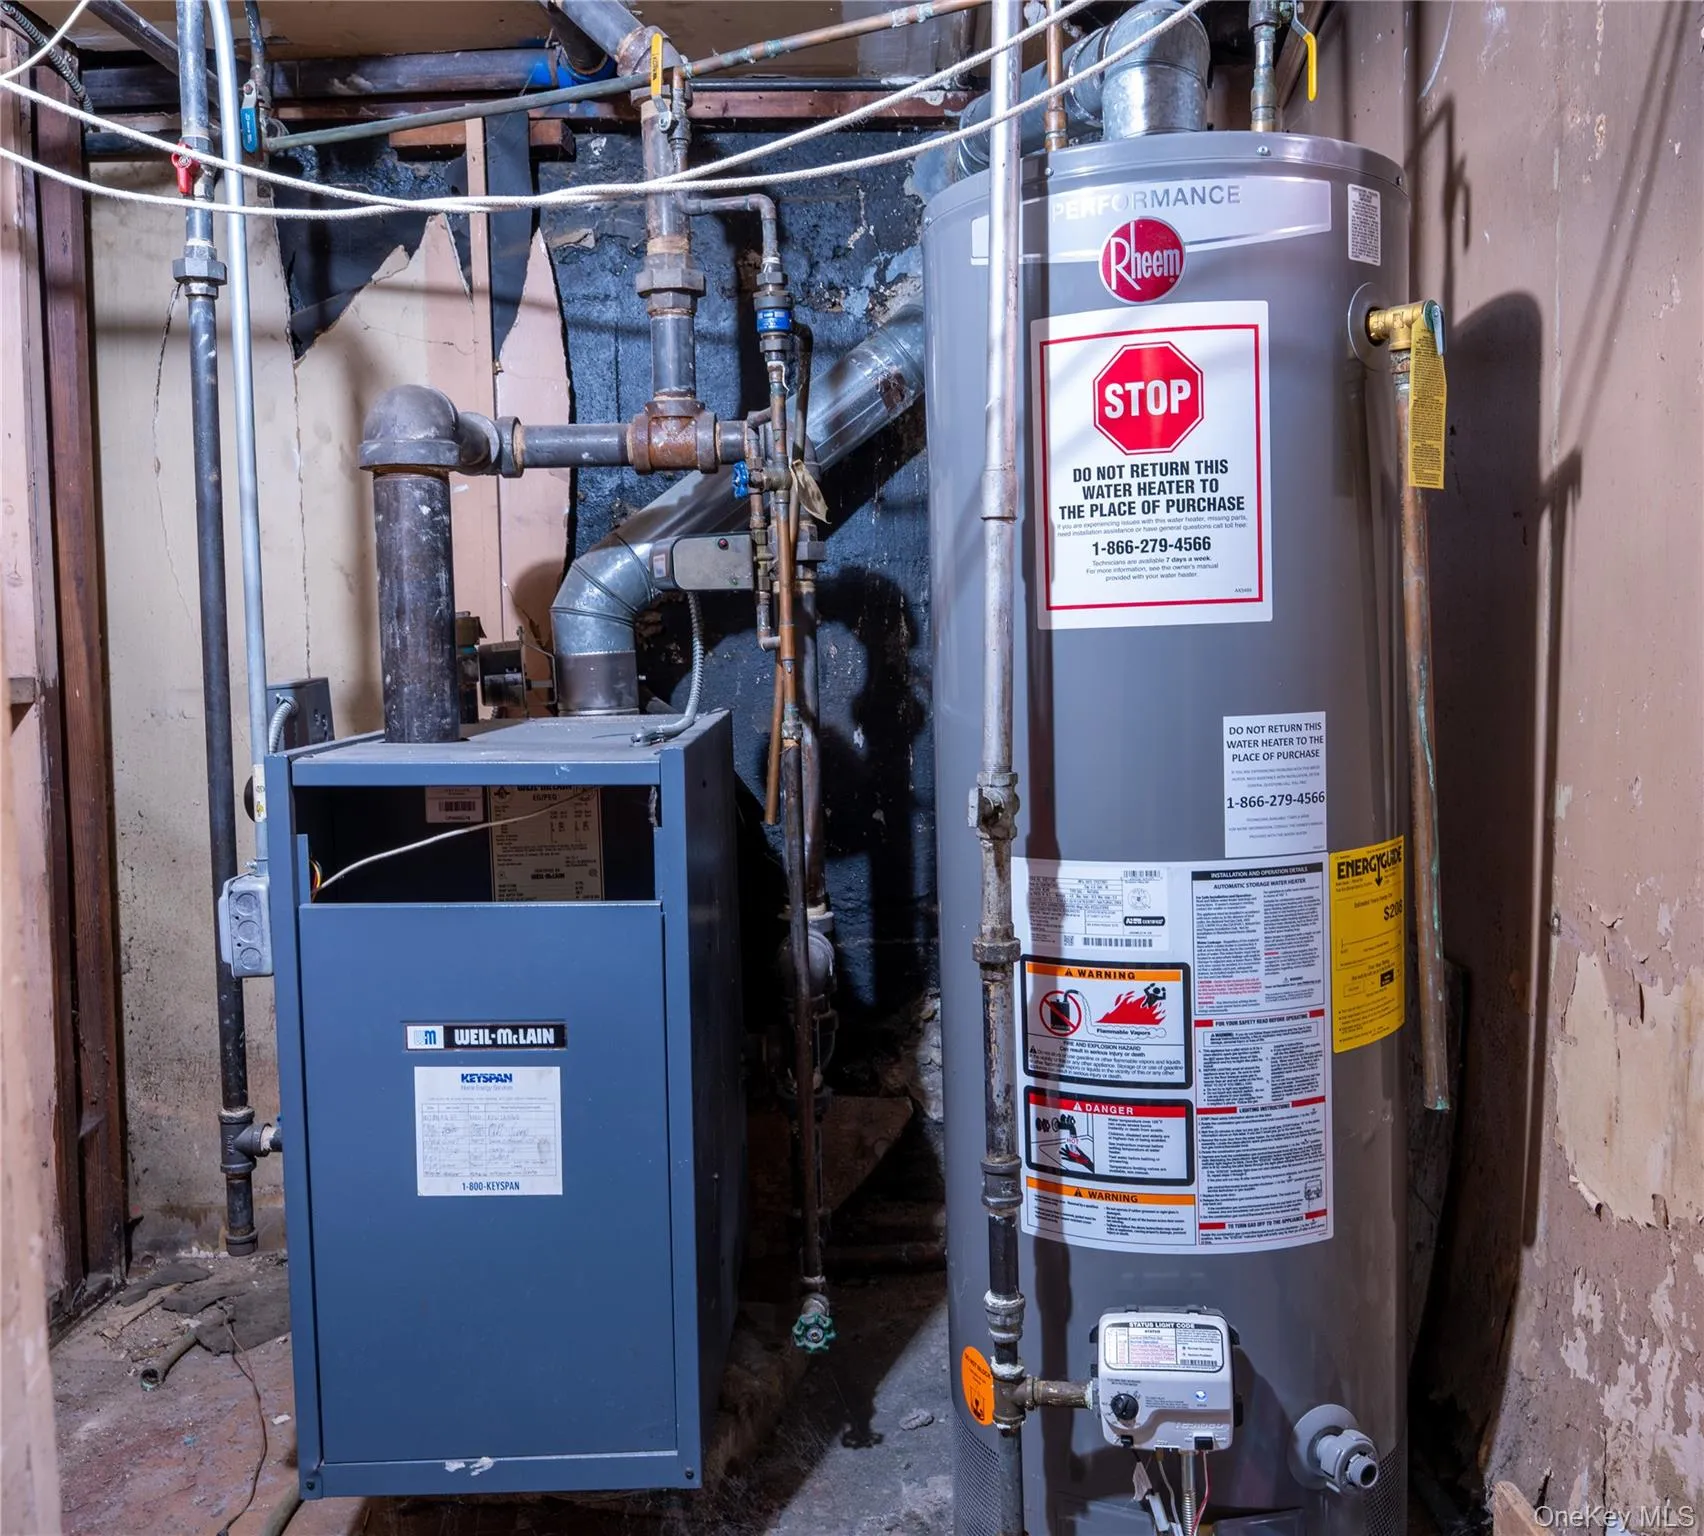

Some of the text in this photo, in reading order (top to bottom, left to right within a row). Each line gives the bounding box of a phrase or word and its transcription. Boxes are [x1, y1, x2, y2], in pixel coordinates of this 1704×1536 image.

[1052, 184, 1241, 222] PERFORMANCE
[1109, 221, 1181, 290] Rheem
[1104, 378, 1192, 419] STOP
[1073, 458, 1229, 483] DO NOT RETURN THIS
[1082, 478, 1219, 500] WATER HEATER TO
[1059, 496, 1245, 520] THE PLACE OF PURCHASE
[1092, 536, 1211, 556] 1-866-279-4566
[1229, 722, 1322, 735] DO NOT RETURN THIS
[1226, 735, 1324, 749] WATER HEATER TO THE
[1232, 749, 1320, 762] PLACE OF PURCHASE
[1227, 791, 1325, 809] 1-866-279-4566
[1211, 871, 1248, 879] INSTALLATION
[1261, 868, 1288, 876] OPERATION
[1078, 968, 1136, 980] WARNING
[461, 1073, 513, 1083] KEYSPAN
[1085, 1104, 1134, 1115] DANGER
[462, 1181, 520, 1192] 1-800-KEYSPAN
[1088, 1190, 1138, 1203] WARNING
